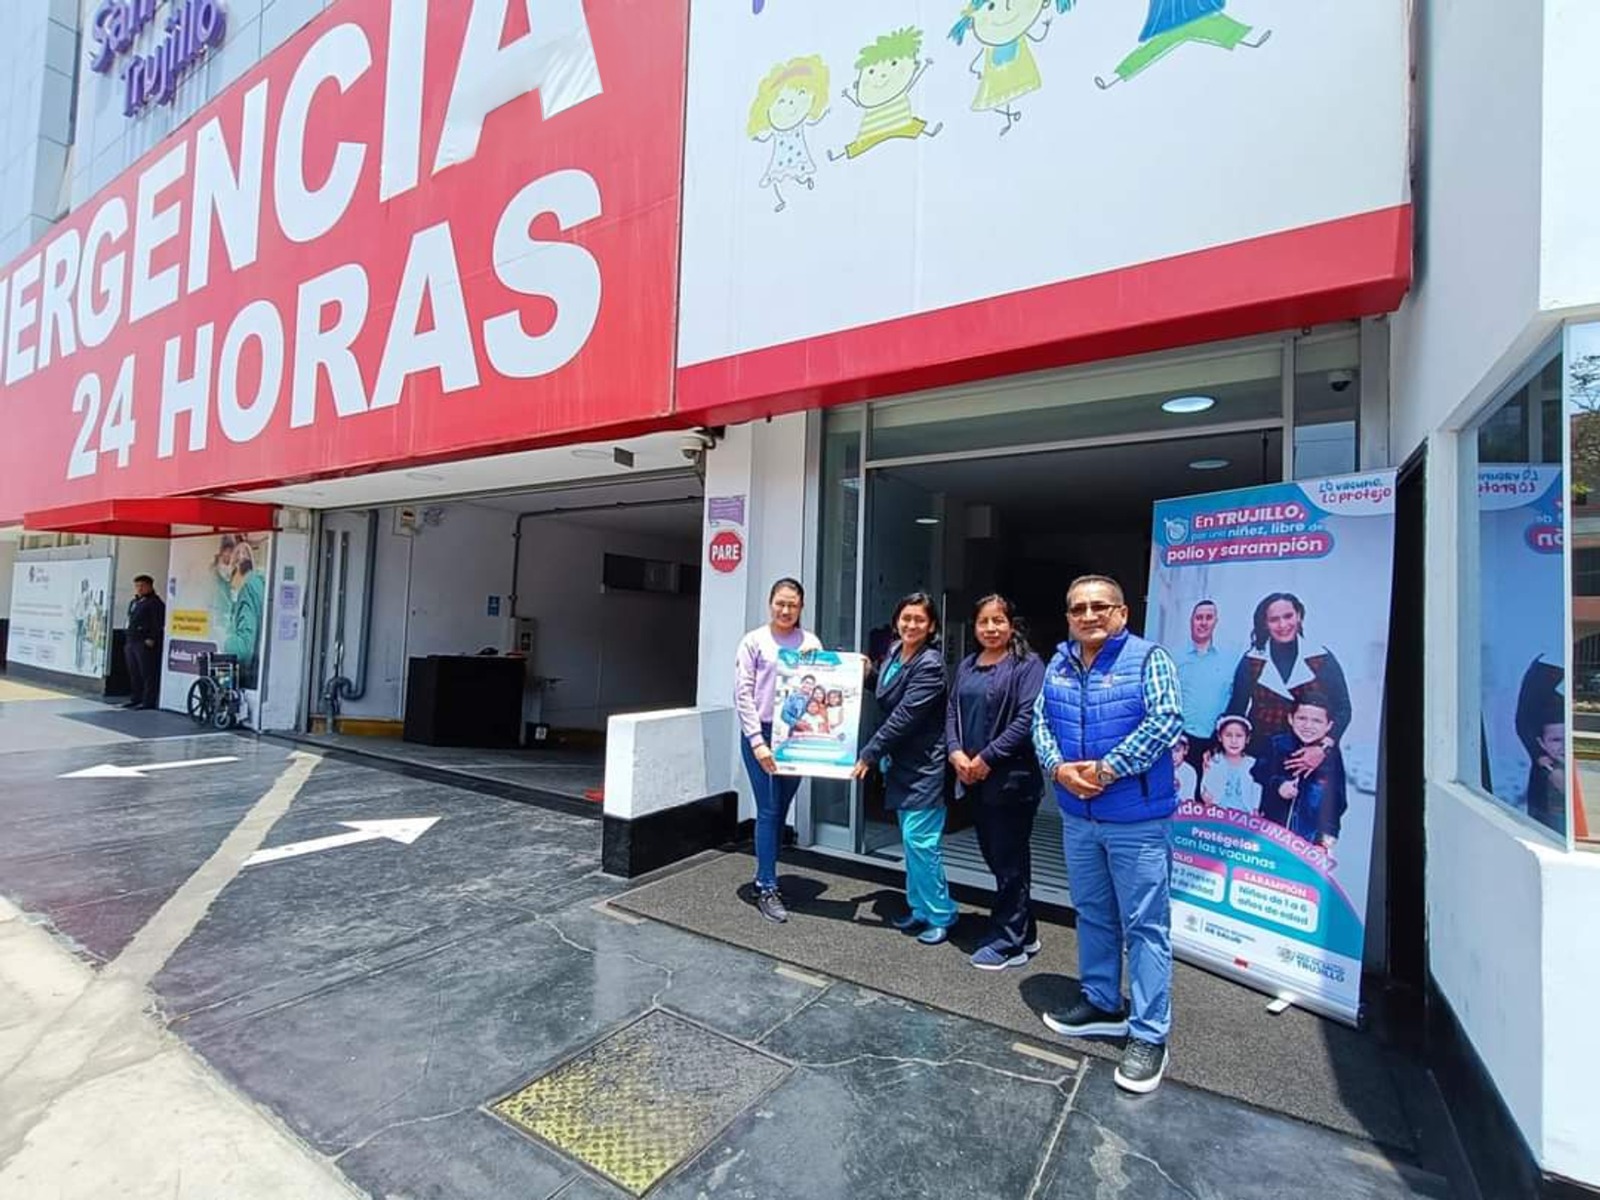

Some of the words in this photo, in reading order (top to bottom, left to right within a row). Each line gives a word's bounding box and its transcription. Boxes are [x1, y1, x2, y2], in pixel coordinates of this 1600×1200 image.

[122, 0, 226, 118] Trujillo
[0, 0, 603, 387] ERGENCIA
[66, 354, 136, 479] 24
[157, 169, 602, 459] HORAS
[1195, 515, 1214, 529] En
[1216, 505, 1305, 525] TRUJILLO,
[1228, 525, 1268, 539] niñez,
[1271, 521, 1305, 534] libre
[711, 543, 740, 561] PARE
[1166, 545, 1205, 564] polio
[1208, 547, 1219, 561] y
[1220, 537, 1323, 556] sarampión
[1207, 805, 1225, 819] de
[1174, 835, 1197, 848] con
[1198, 838, 1218, 854] las
[1220, 847, 1277, 870] vacunas
